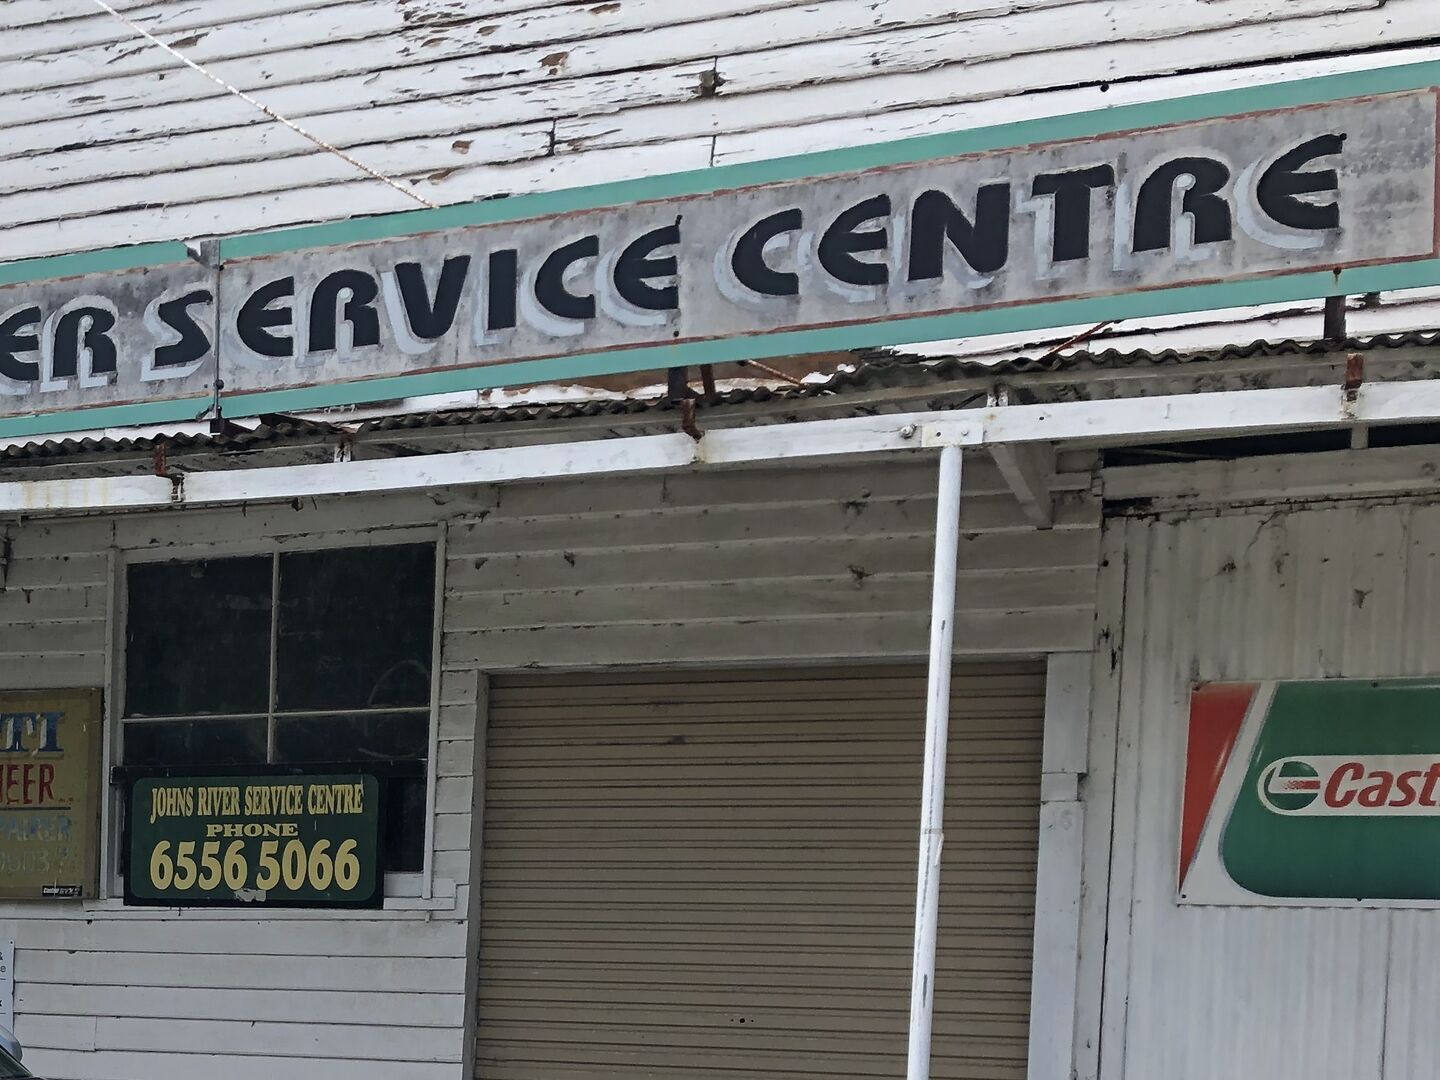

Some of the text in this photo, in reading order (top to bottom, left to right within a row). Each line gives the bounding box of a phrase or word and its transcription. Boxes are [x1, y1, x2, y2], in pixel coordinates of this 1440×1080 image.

[140, 223, 682, 382] SERVICE
[712, 133, 1344, 303] CENTRE
[150, 783, 364, 824] JOHNS RIVER SERVICE CENTRE
[206, 823, 298, 838] PHONE
[149, 838, 360, 891] 6556 5066
